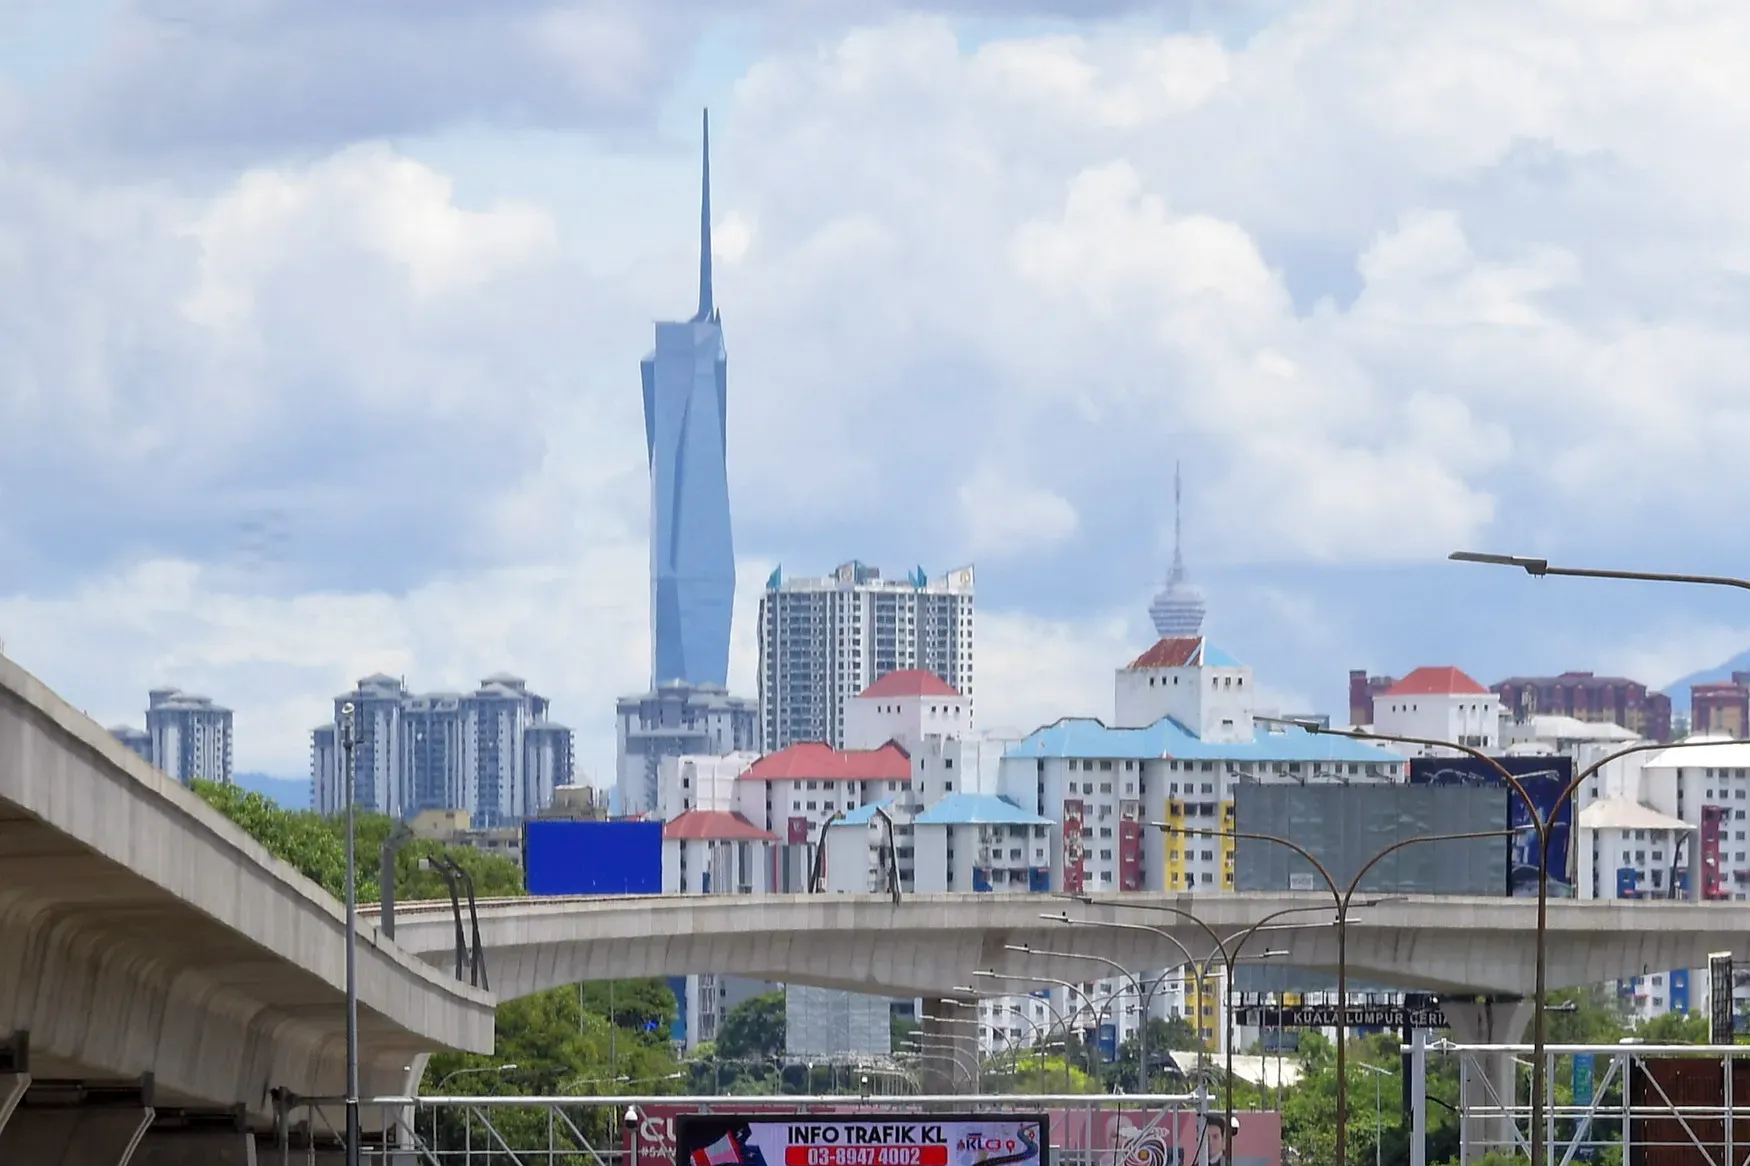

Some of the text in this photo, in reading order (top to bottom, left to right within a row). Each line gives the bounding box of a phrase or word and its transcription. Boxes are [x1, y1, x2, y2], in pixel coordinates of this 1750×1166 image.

[1293, 1011, 1339, 1024] KUALA
[1346, 1011, 1404, 1024] LUMPUR
[788, 1126, 947, 1144] INFO TRAFIK KL
[808, 1147, 920, 1165] 03-8947 4002
